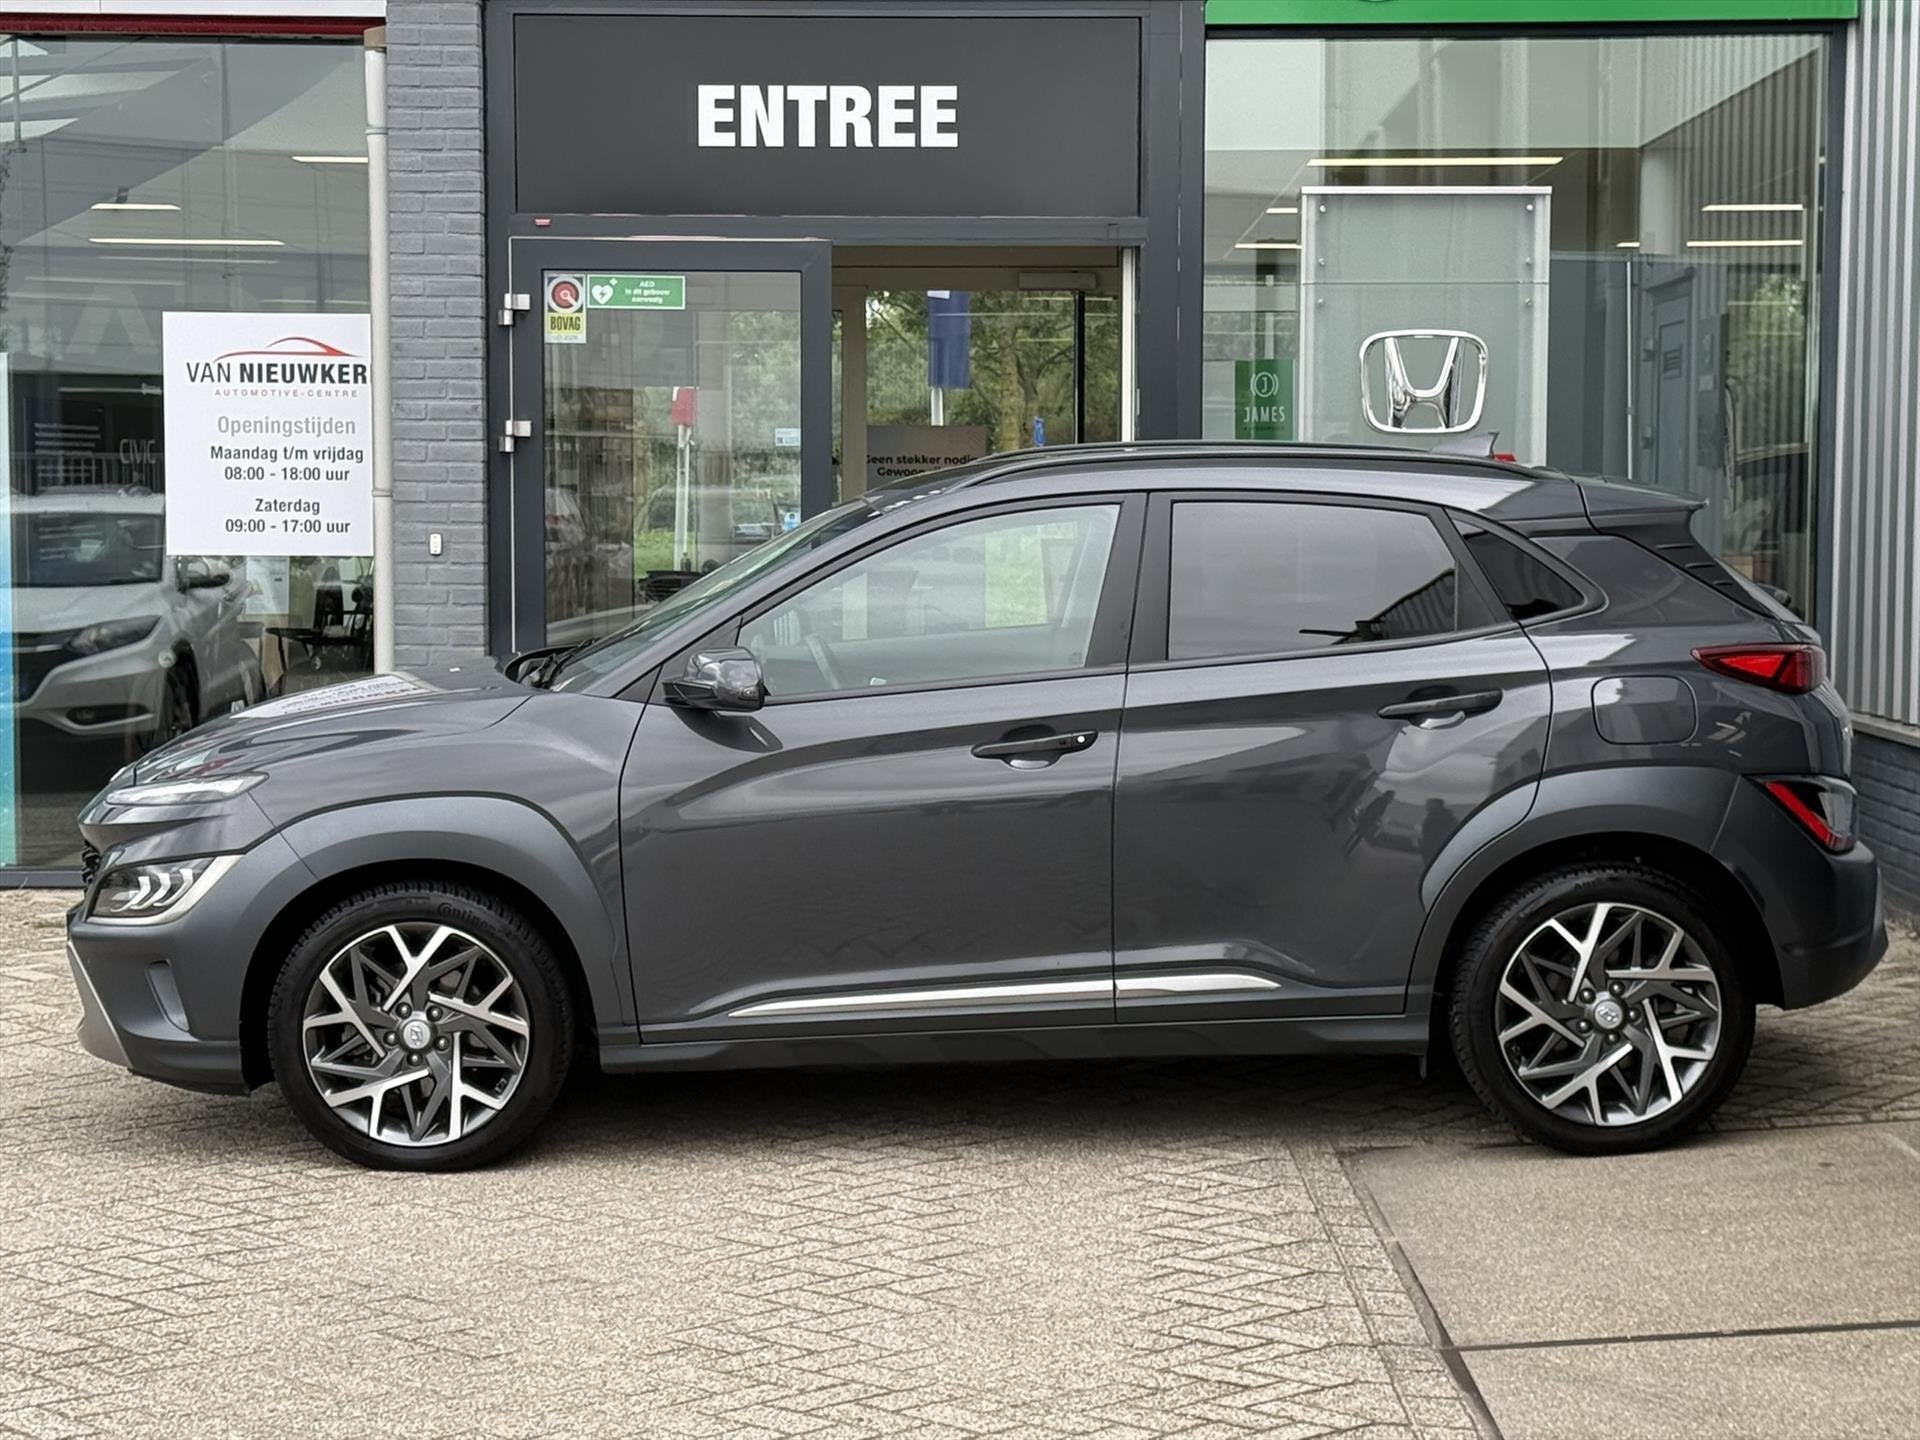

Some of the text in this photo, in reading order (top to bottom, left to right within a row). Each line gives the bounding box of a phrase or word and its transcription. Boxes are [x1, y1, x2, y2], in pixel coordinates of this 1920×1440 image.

[697, 84, 959, 148] ENTREE
[550, 315, 581, 331] BOVAG
[186, 362, 373, 385] VAN NIEUWKER
[214, 388, 358, 398] AUTOMOTIVE-CENTRE
[1243, 406, 1286, 423] JAMES
[217, 416, 356, 438] Openingstijden
[119, 438, 157, 464] CIVIC
[210, 446, 364, 464] Maandag t/m vrijdag
[896, 455, 941, 465] stekker
[944, 454, 978, 465] nodi
[224, 466, 265, 481] 08:00
[281, 467, 321, 481] 18:00
[325, 469, 350, 481] uur
[255, 499, 320, 515] Zaterdag
[225, 518, 266, 533] 09:00
[282, 519, 322, 533] 17:00
[326, 521, 351, 533] uur
